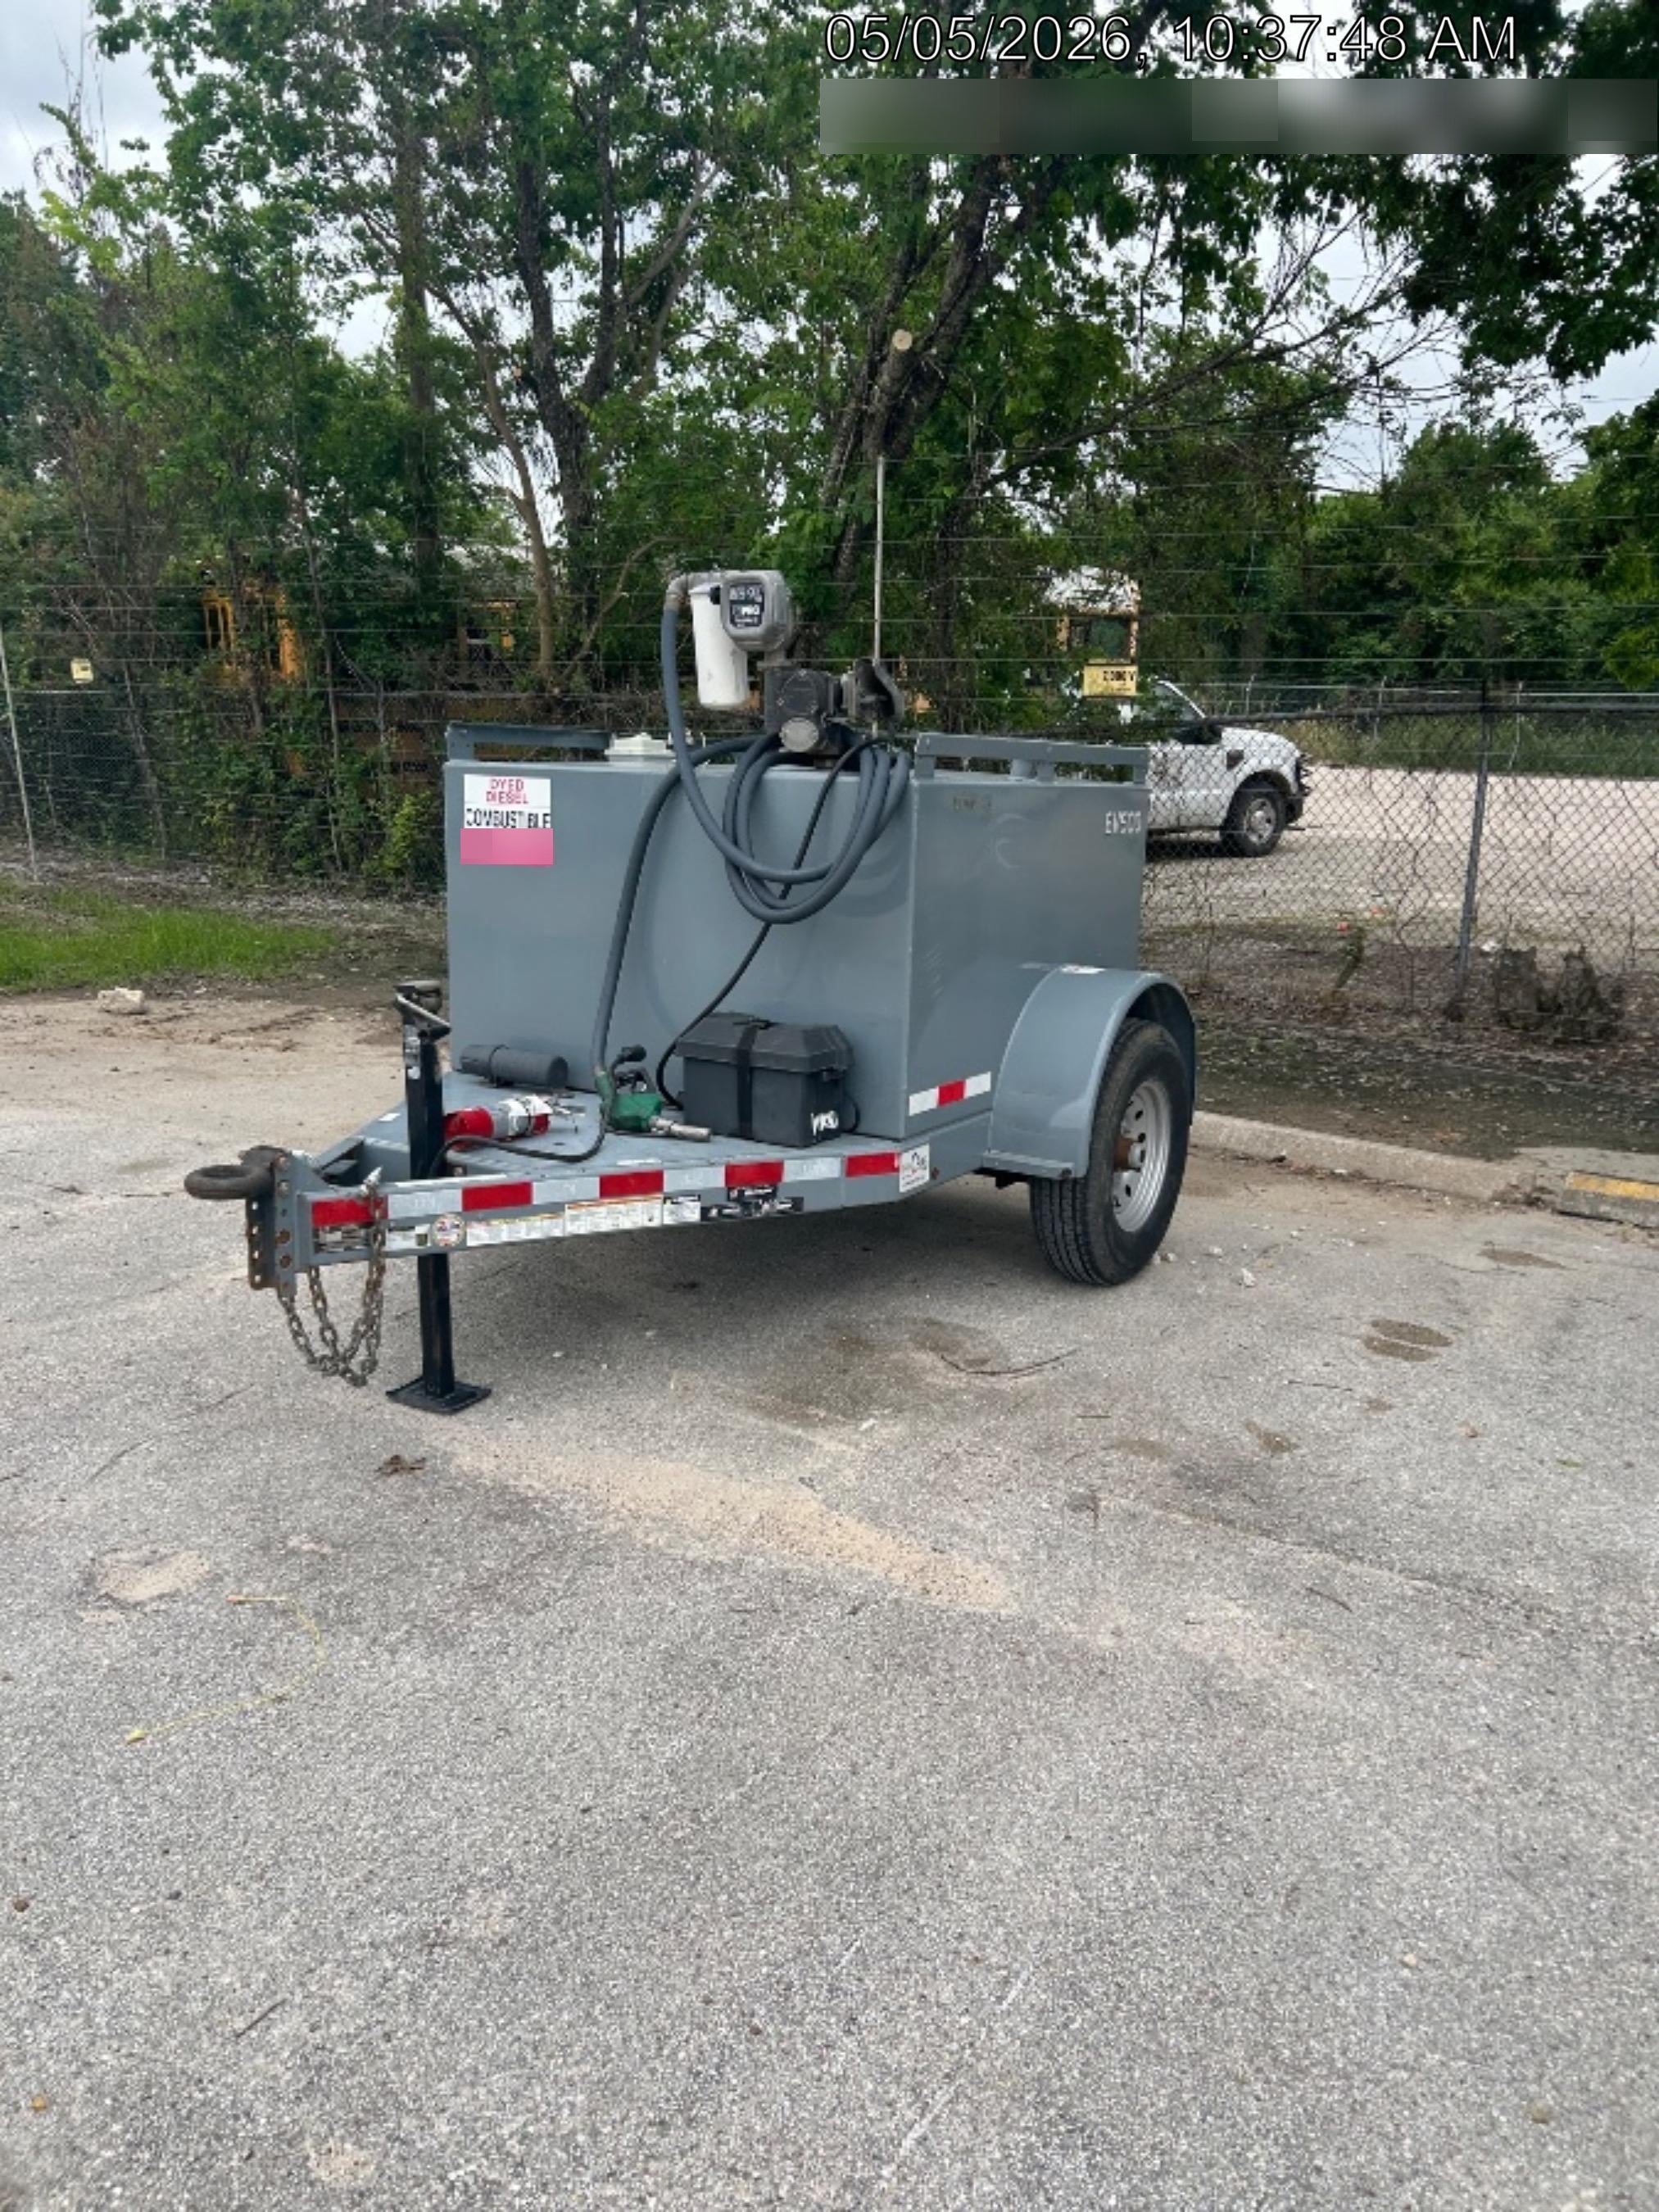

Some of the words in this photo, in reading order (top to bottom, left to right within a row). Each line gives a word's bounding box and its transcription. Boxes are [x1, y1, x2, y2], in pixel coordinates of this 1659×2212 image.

[491, 778, 524, 792] DYED
[486, 791, 528, 805] DIESEL
[466, 808, 551, 828] COMBUSTBLE
